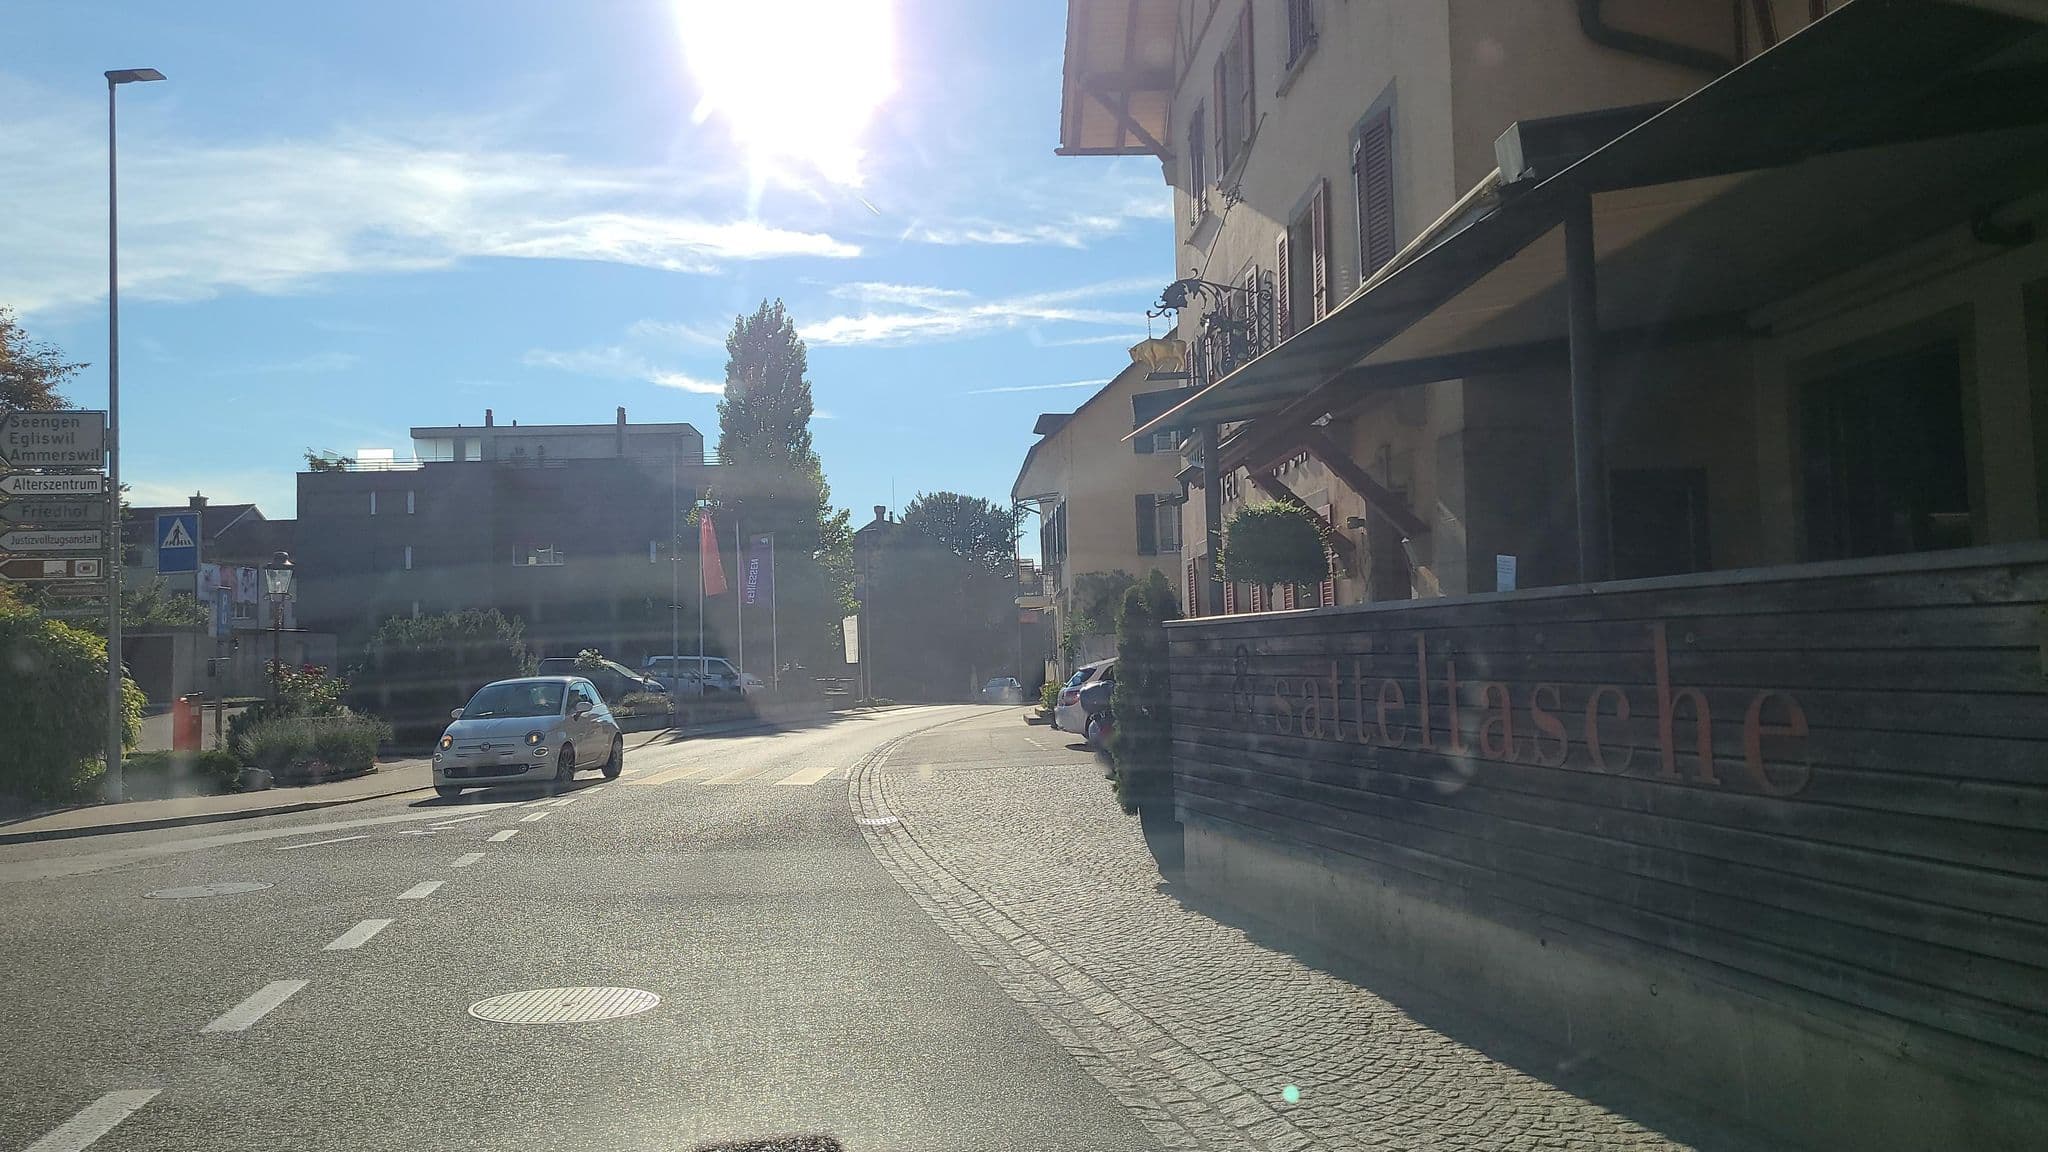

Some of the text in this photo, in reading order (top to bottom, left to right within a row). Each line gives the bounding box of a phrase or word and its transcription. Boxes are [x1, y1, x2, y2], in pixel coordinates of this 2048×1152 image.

[10, 415, 80, 431] Seengen
[9, 432, 75, 447] Egliswil
[11, 448, 99, 461] Ammerswil
[13, 479, 98, 490] Alterszentrum
[22, 504, 88, 517] Friedhof
[11, 535, 98, 546] Justizvollzugsanstalt
[1273, 622, 1811, 796] satteltasche
